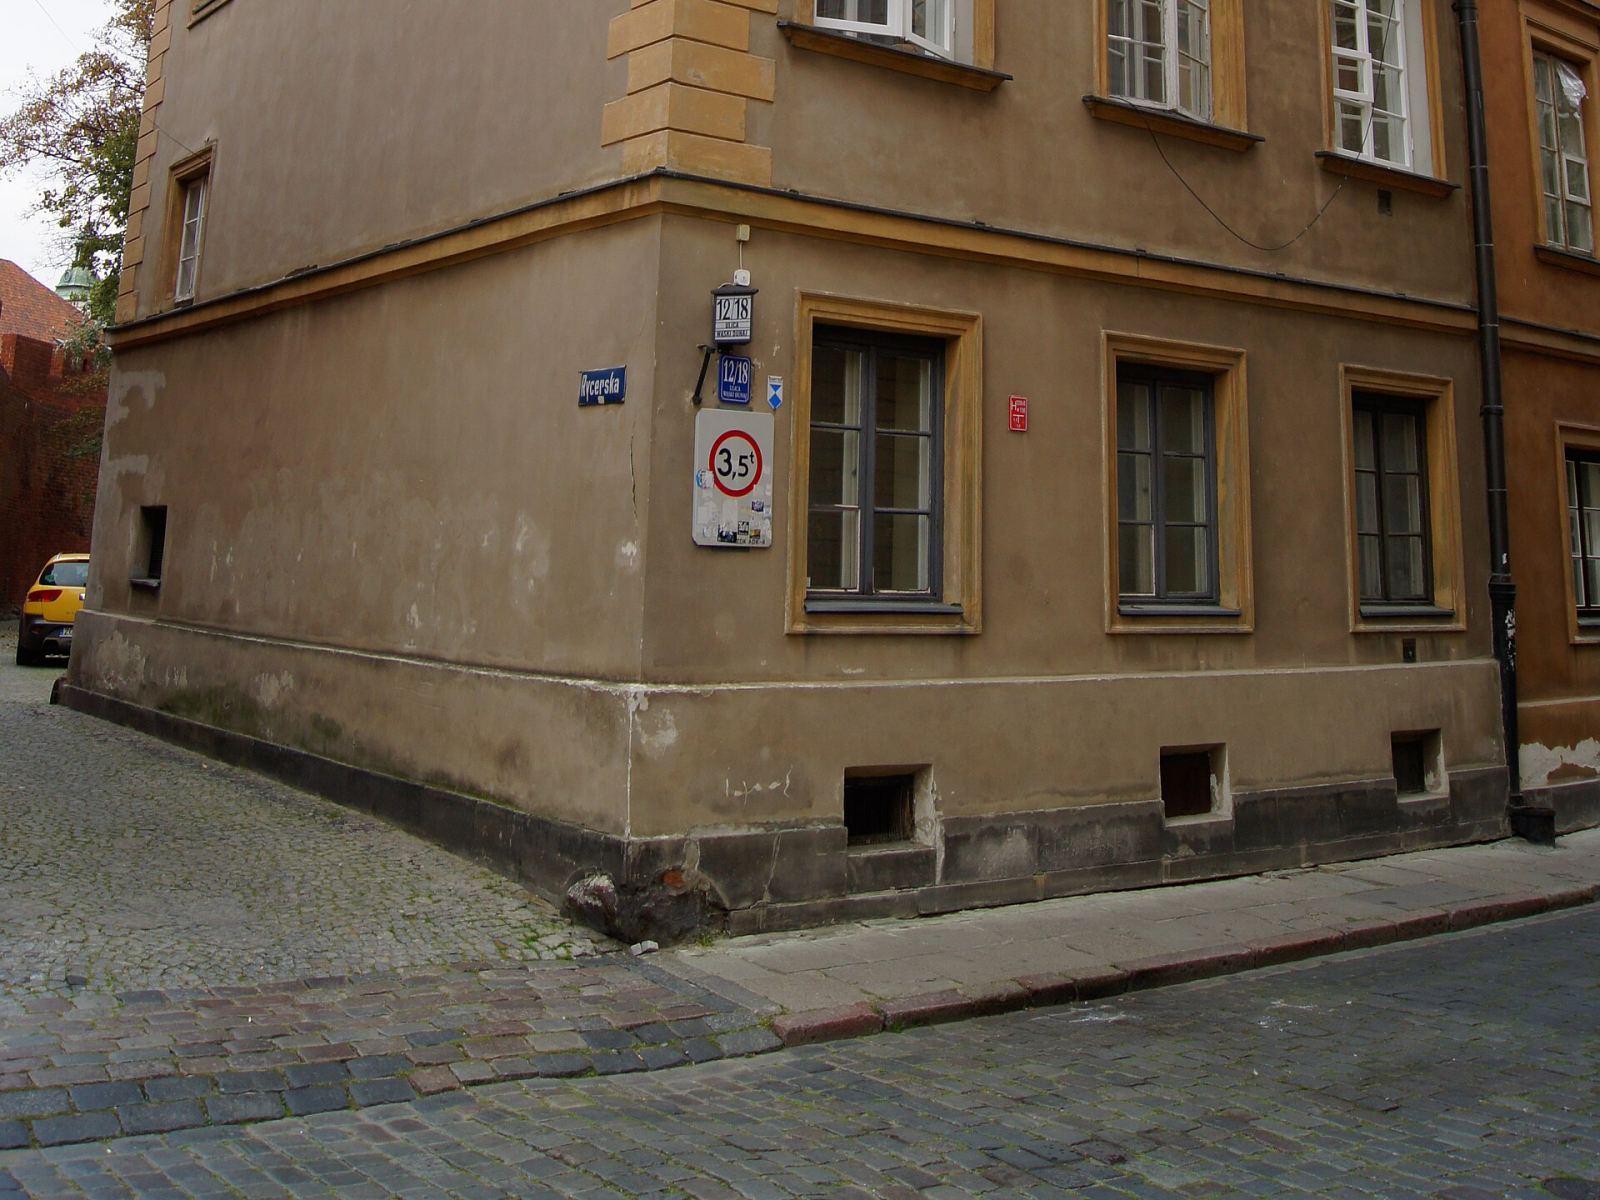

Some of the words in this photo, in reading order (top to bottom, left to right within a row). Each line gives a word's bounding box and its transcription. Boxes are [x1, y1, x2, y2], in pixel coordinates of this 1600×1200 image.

[717, 297, 748, 320] 12/18
[723, 359, 748, 386] 12/18
[581, 371, 619, 402] Rycerska
